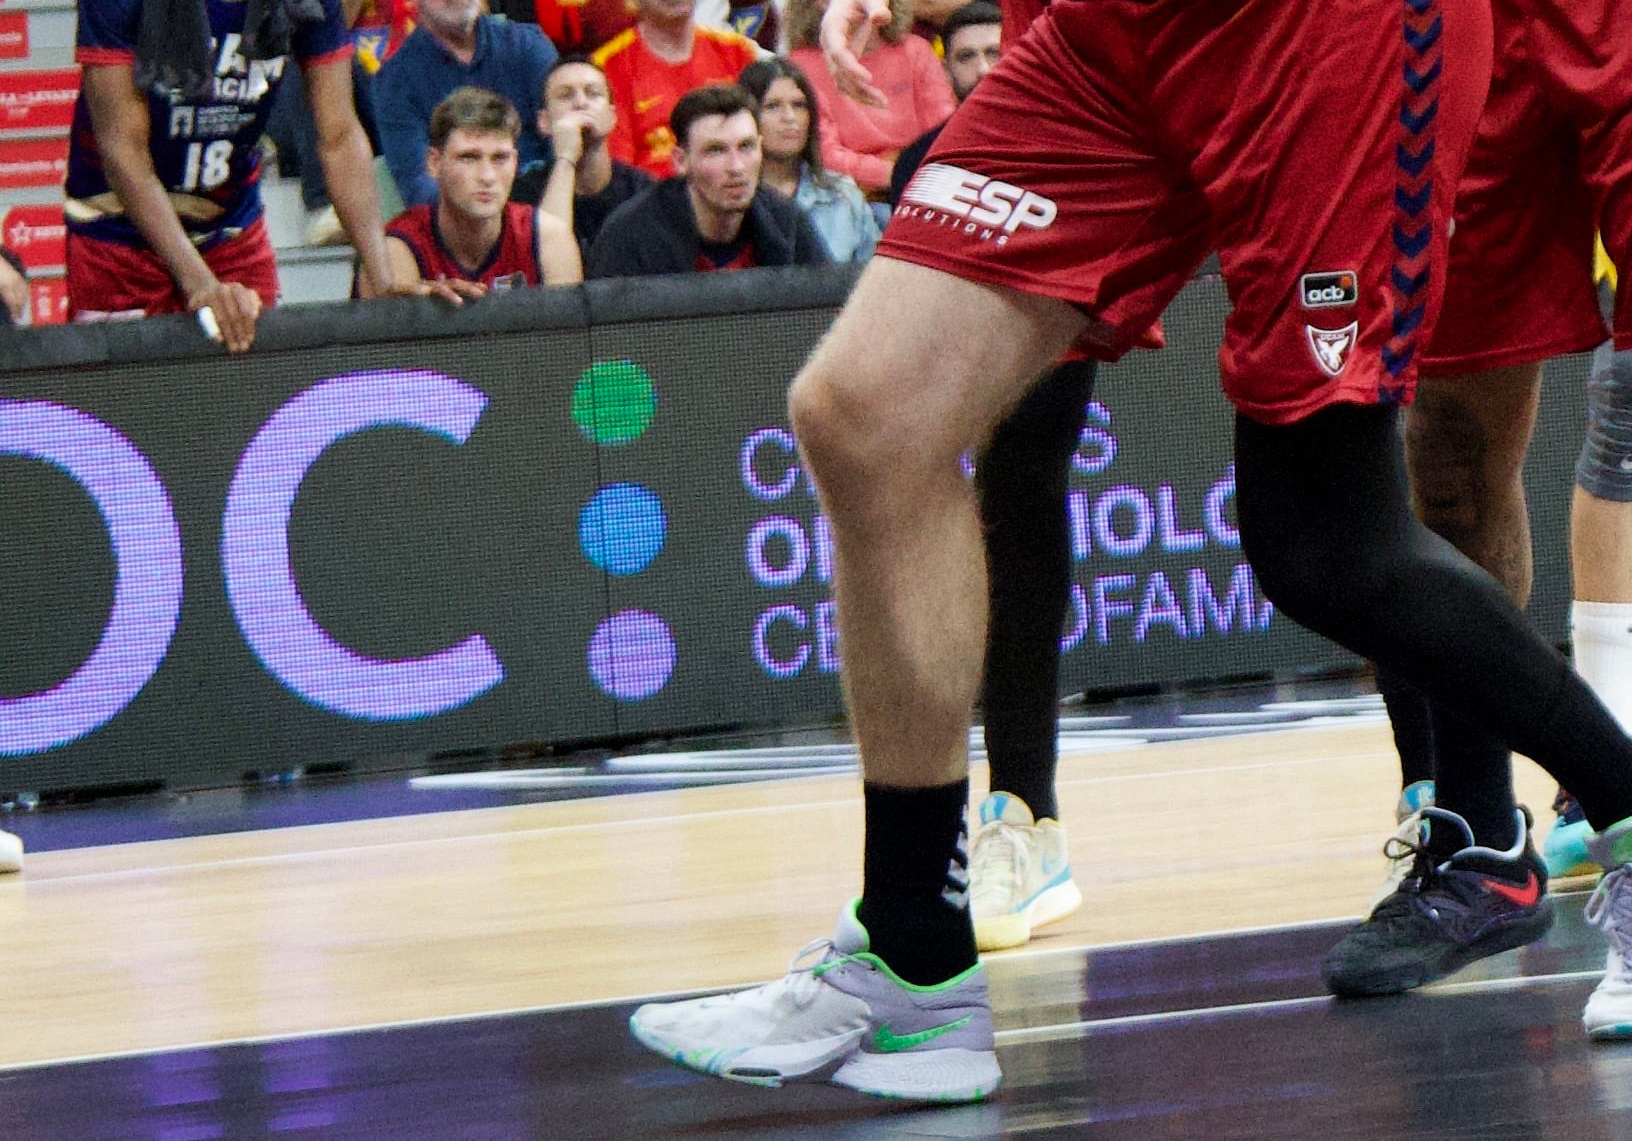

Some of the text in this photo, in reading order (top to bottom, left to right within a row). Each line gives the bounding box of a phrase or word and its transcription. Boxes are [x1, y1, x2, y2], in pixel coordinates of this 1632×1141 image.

[184, 140, 234, 192] 18
[904, 163, 1058, 234] ESP
[1308, 285, 1345, 302] acb
